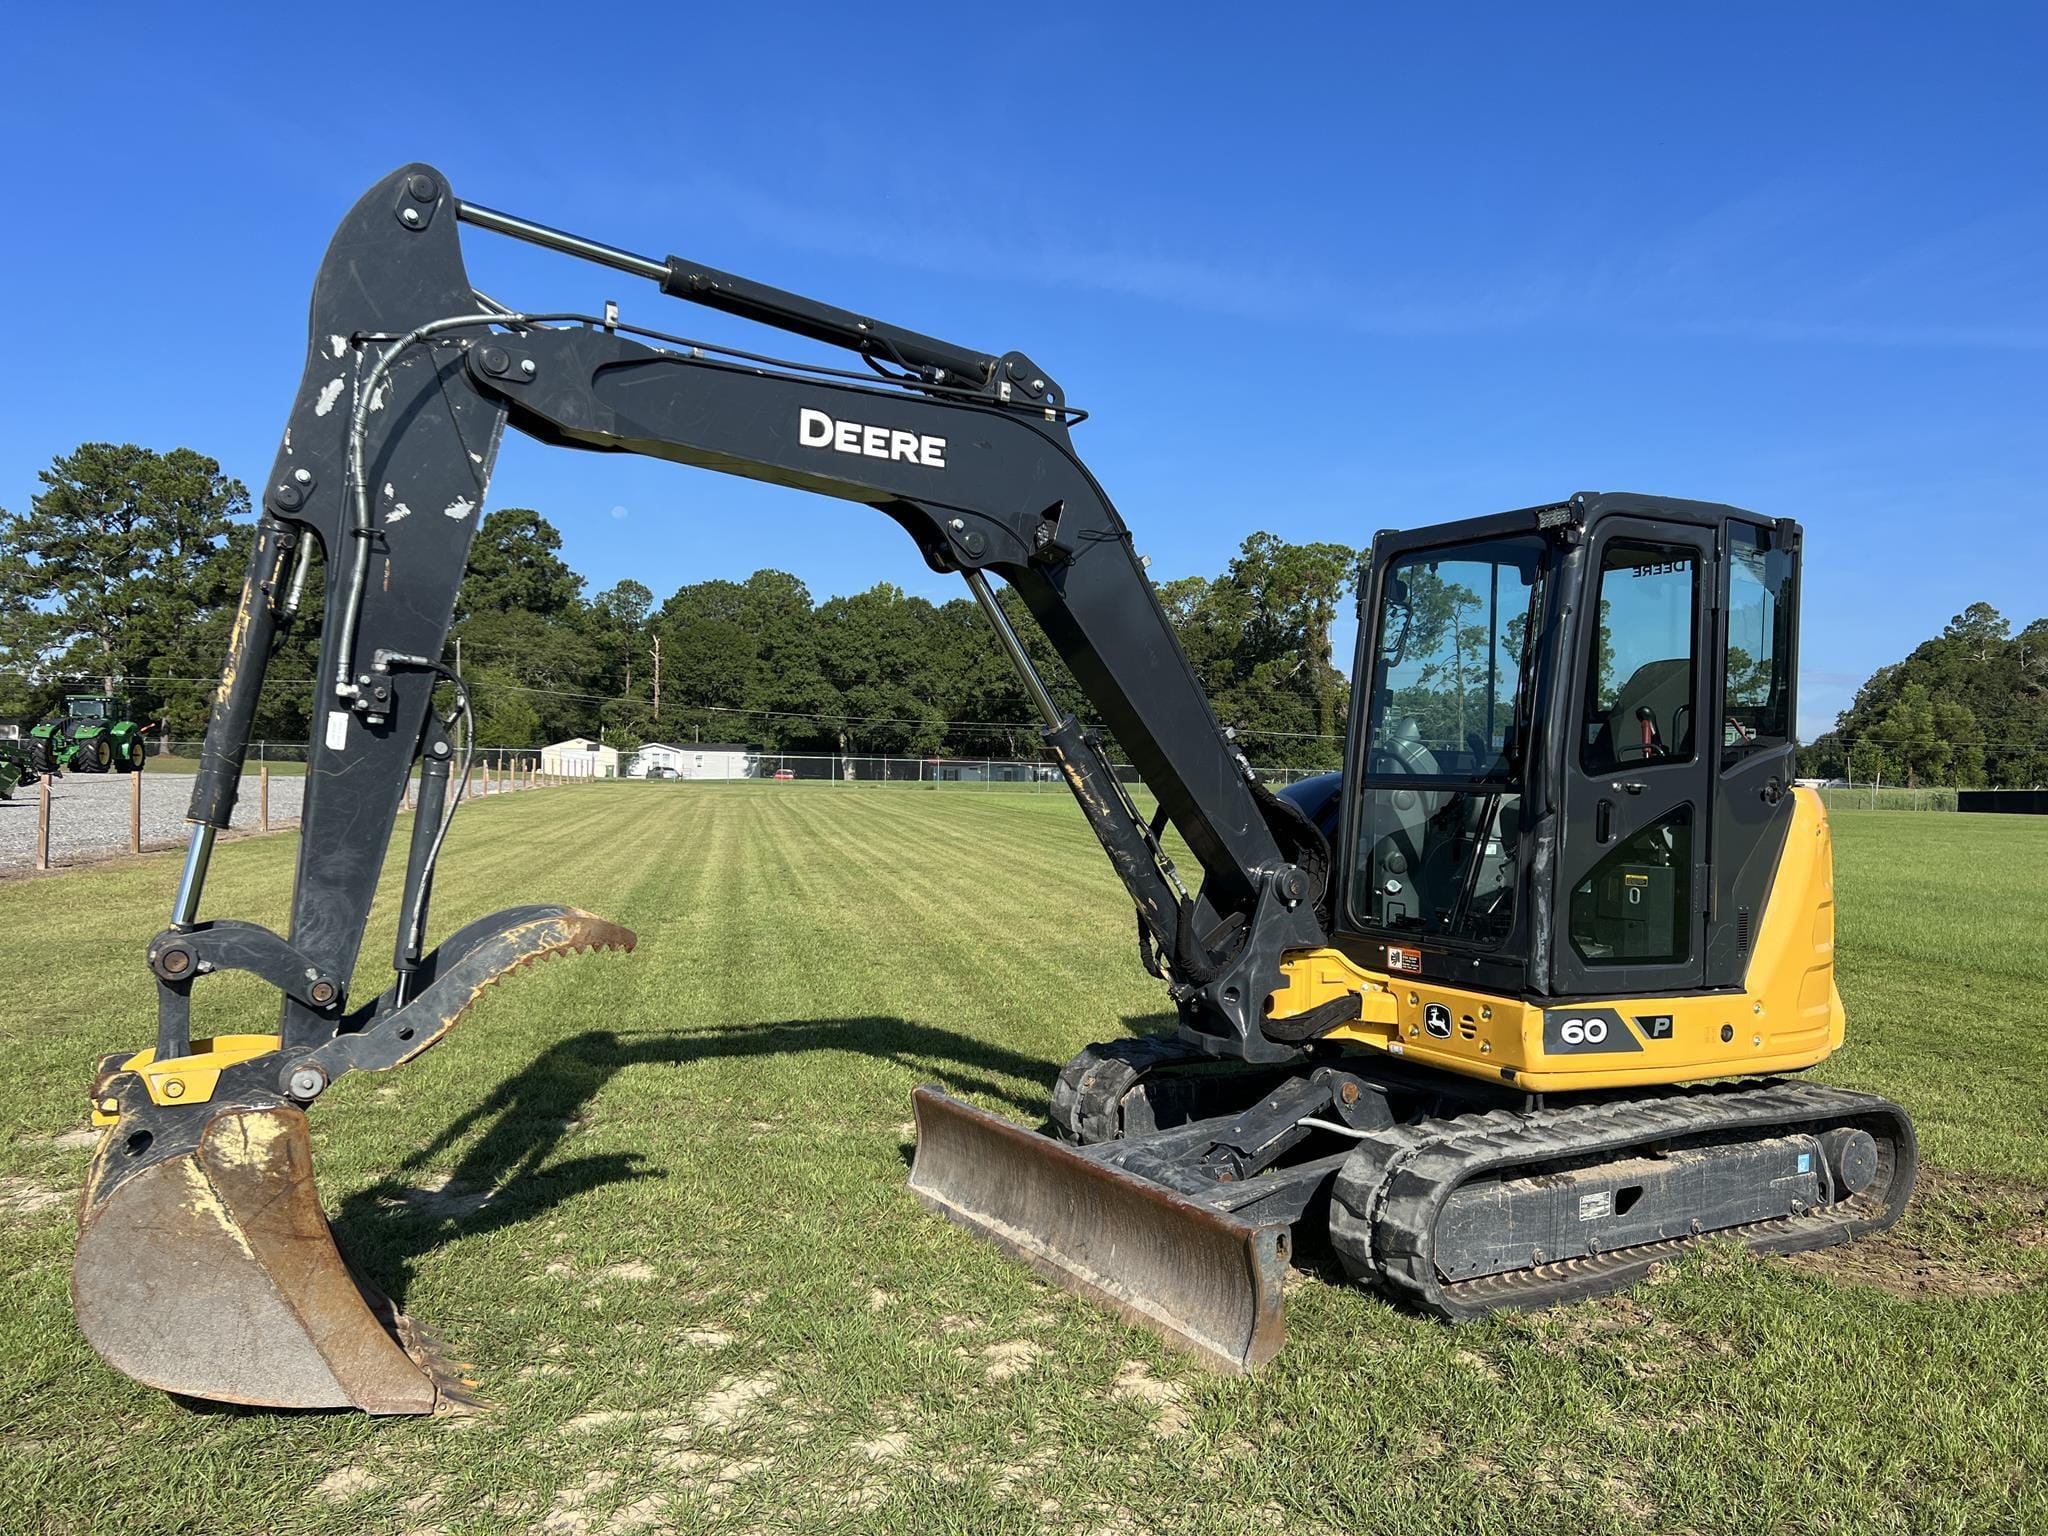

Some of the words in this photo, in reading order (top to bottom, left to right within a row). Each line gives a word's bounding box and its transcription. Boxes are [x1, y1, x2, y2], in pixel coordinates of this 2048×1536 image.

[799, 408, 946, 468] DEERE
[1561, 1018, 1608, 1044] 60
[1653, 1018, 1670, 1037] P
